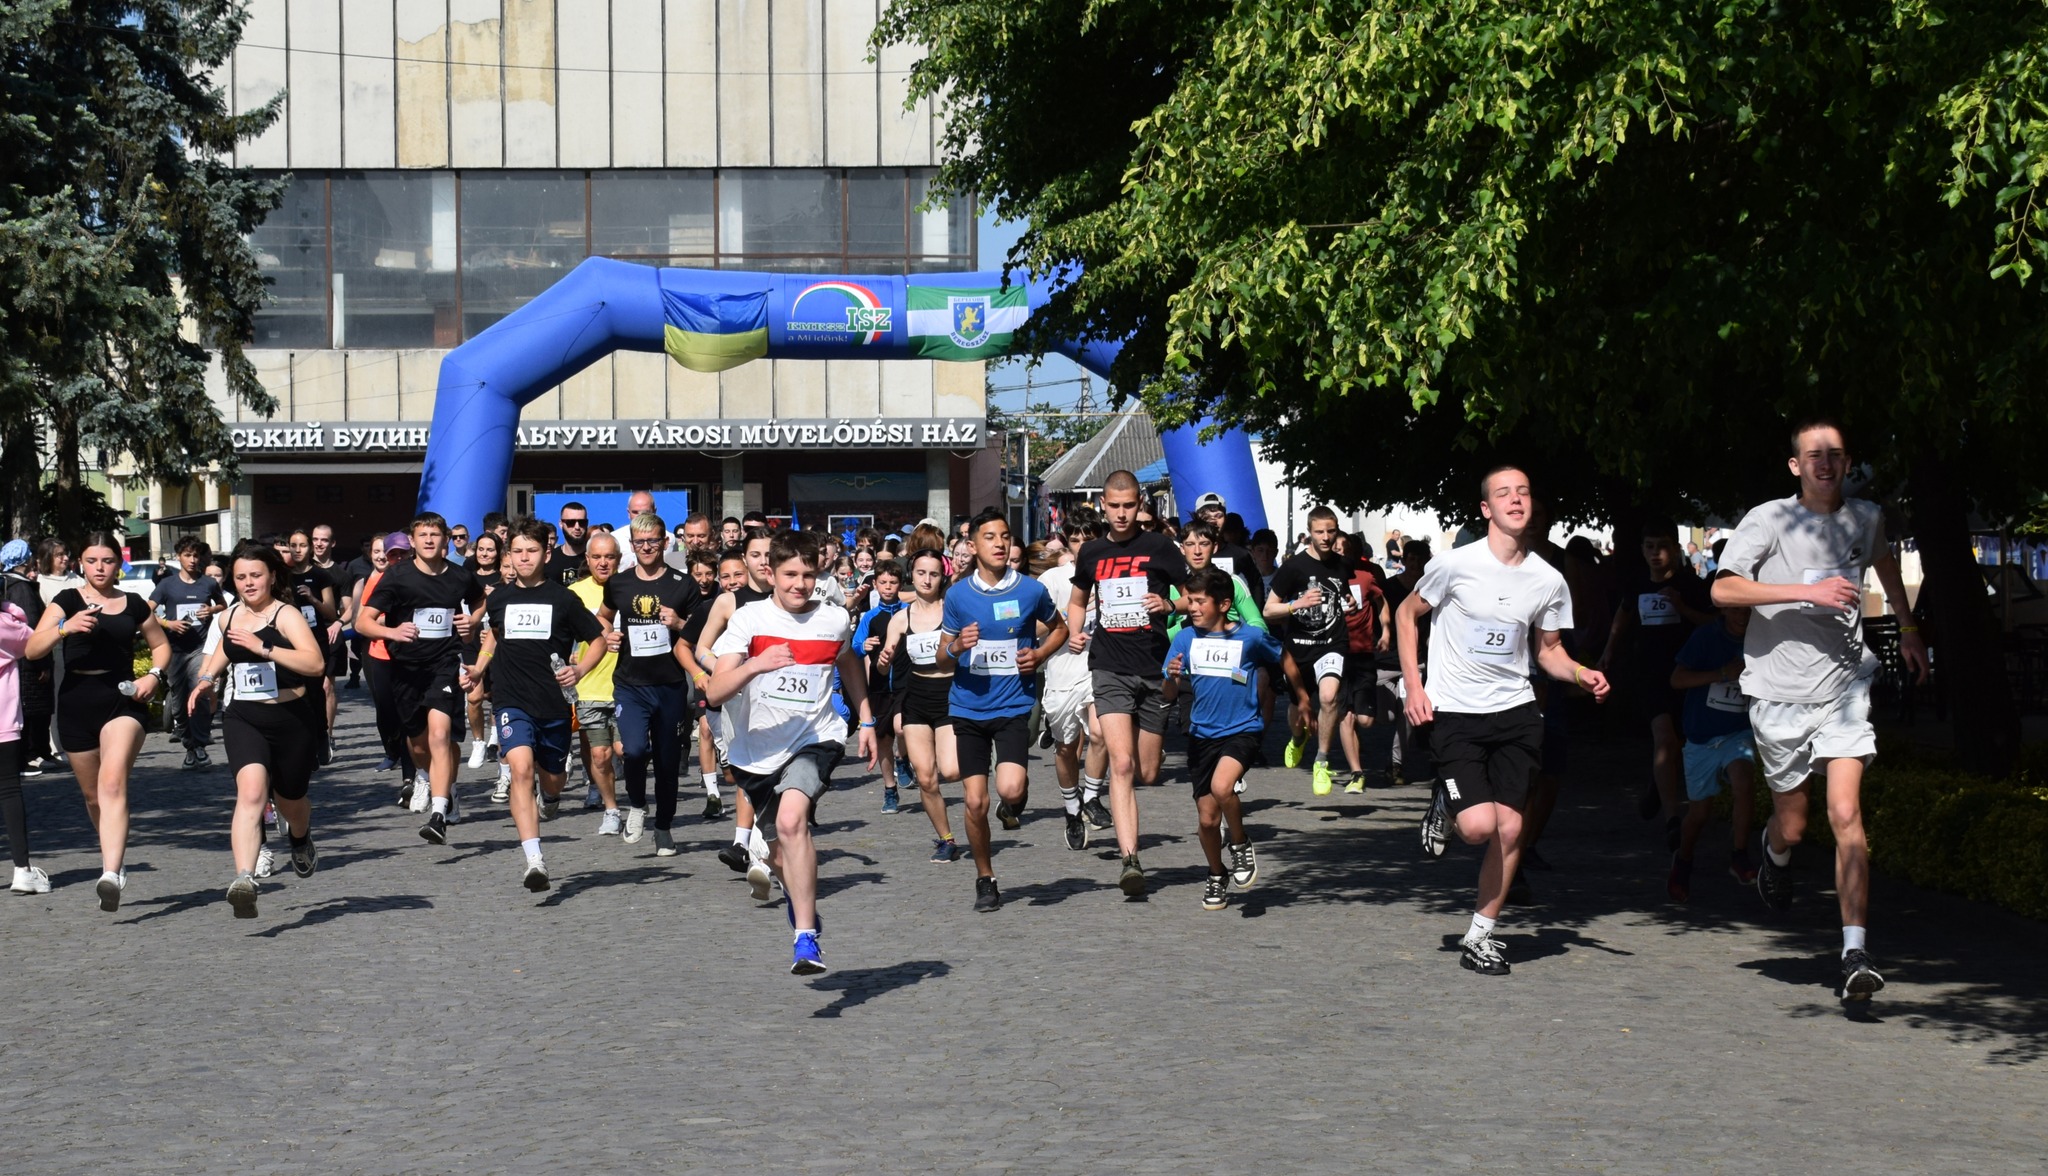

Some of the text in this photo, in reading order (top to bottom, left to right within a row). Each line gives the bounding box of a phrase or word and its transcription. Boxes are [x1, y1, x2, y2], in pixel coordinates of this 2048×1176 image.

[845, 306, 893, 333] ISZ
[630, 414, 978, 446] VÁROSI MŰVELŐDÉSI HÁZ
[332, 427, 431, 450] БУДИН
[1095, 556, 1151, 581] UFC
[1115, 585, 1133, 599] 31
[1651, 600, 1666, 611] 26
[427, 614, 443, 625] 40
[517, 613, 541, 626] 220
[627, 617, 654, 625] COLLINS
[643, 630, 658, 642] 14
[1485, 632, 1506, 647] 29
[983, 650, 1008, 663] 165
[1205, 649, 1229, 663] 164
[244, 673, 263, 687] 161
[776, 676, 809, 694] 238
[501, 712, 509, 726] 6
